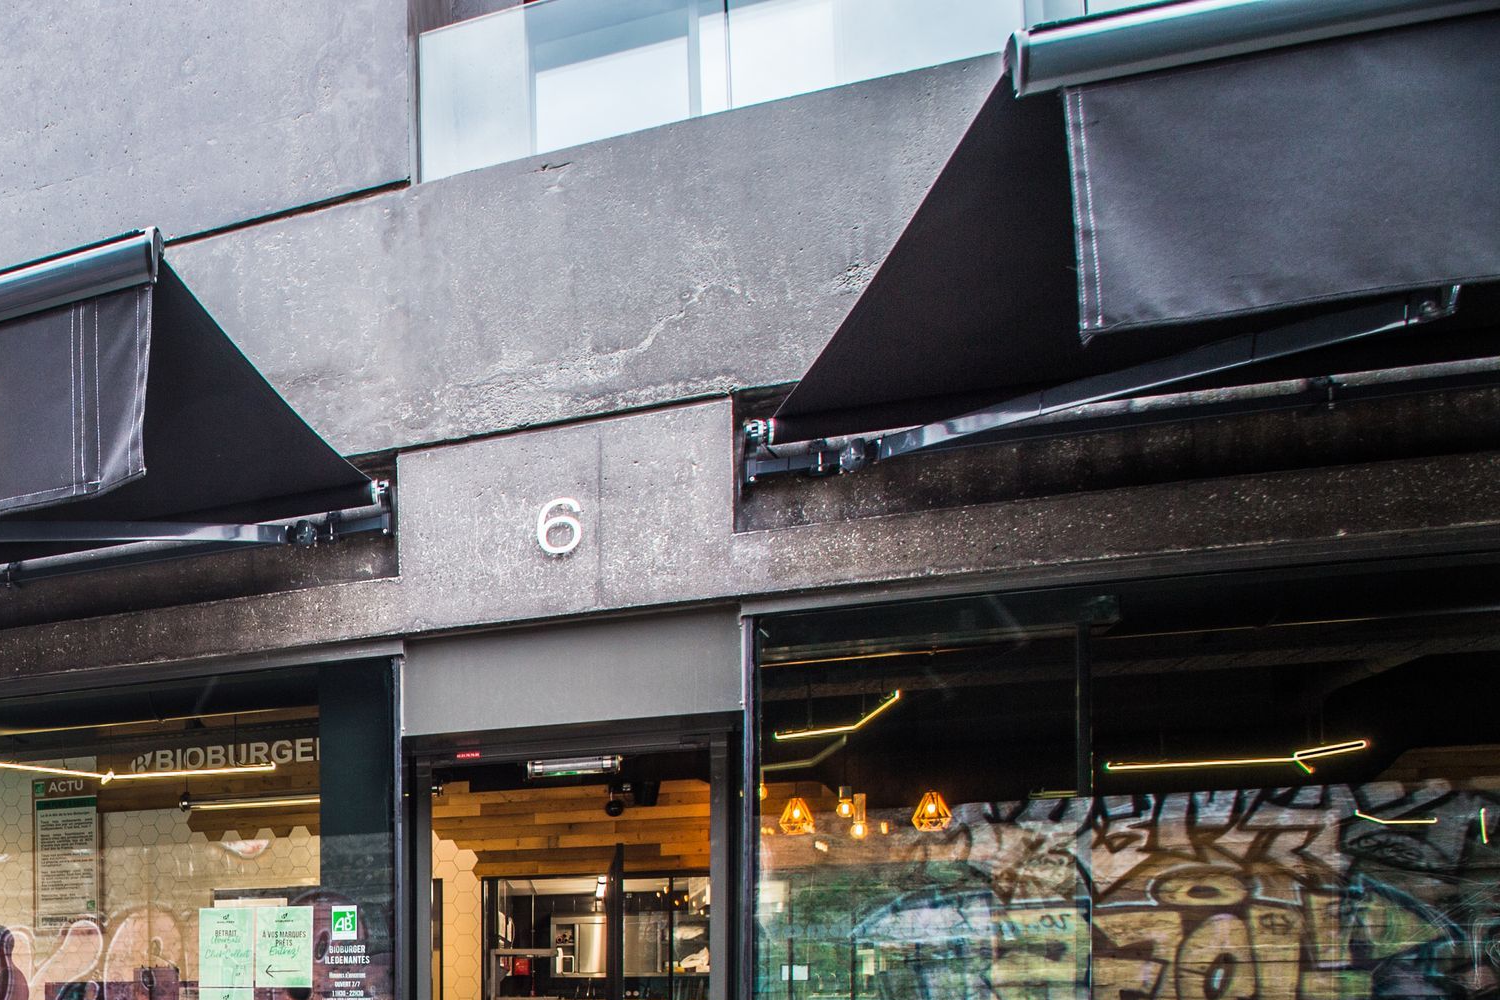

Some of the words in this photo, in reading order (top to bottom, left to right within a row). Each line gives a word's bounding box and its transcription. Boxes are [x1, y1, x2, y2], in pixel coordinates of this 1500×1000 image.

[537, 497, 582, 554] 6
[155, 737, 320, 772] BIOBURGE
[48, 780, 84, 793] ACTU
[334, 916, 353, 932] AB
[279, 930, 307, 939] MARQUES
[329, 944, 366, 954] BIOBURGER
